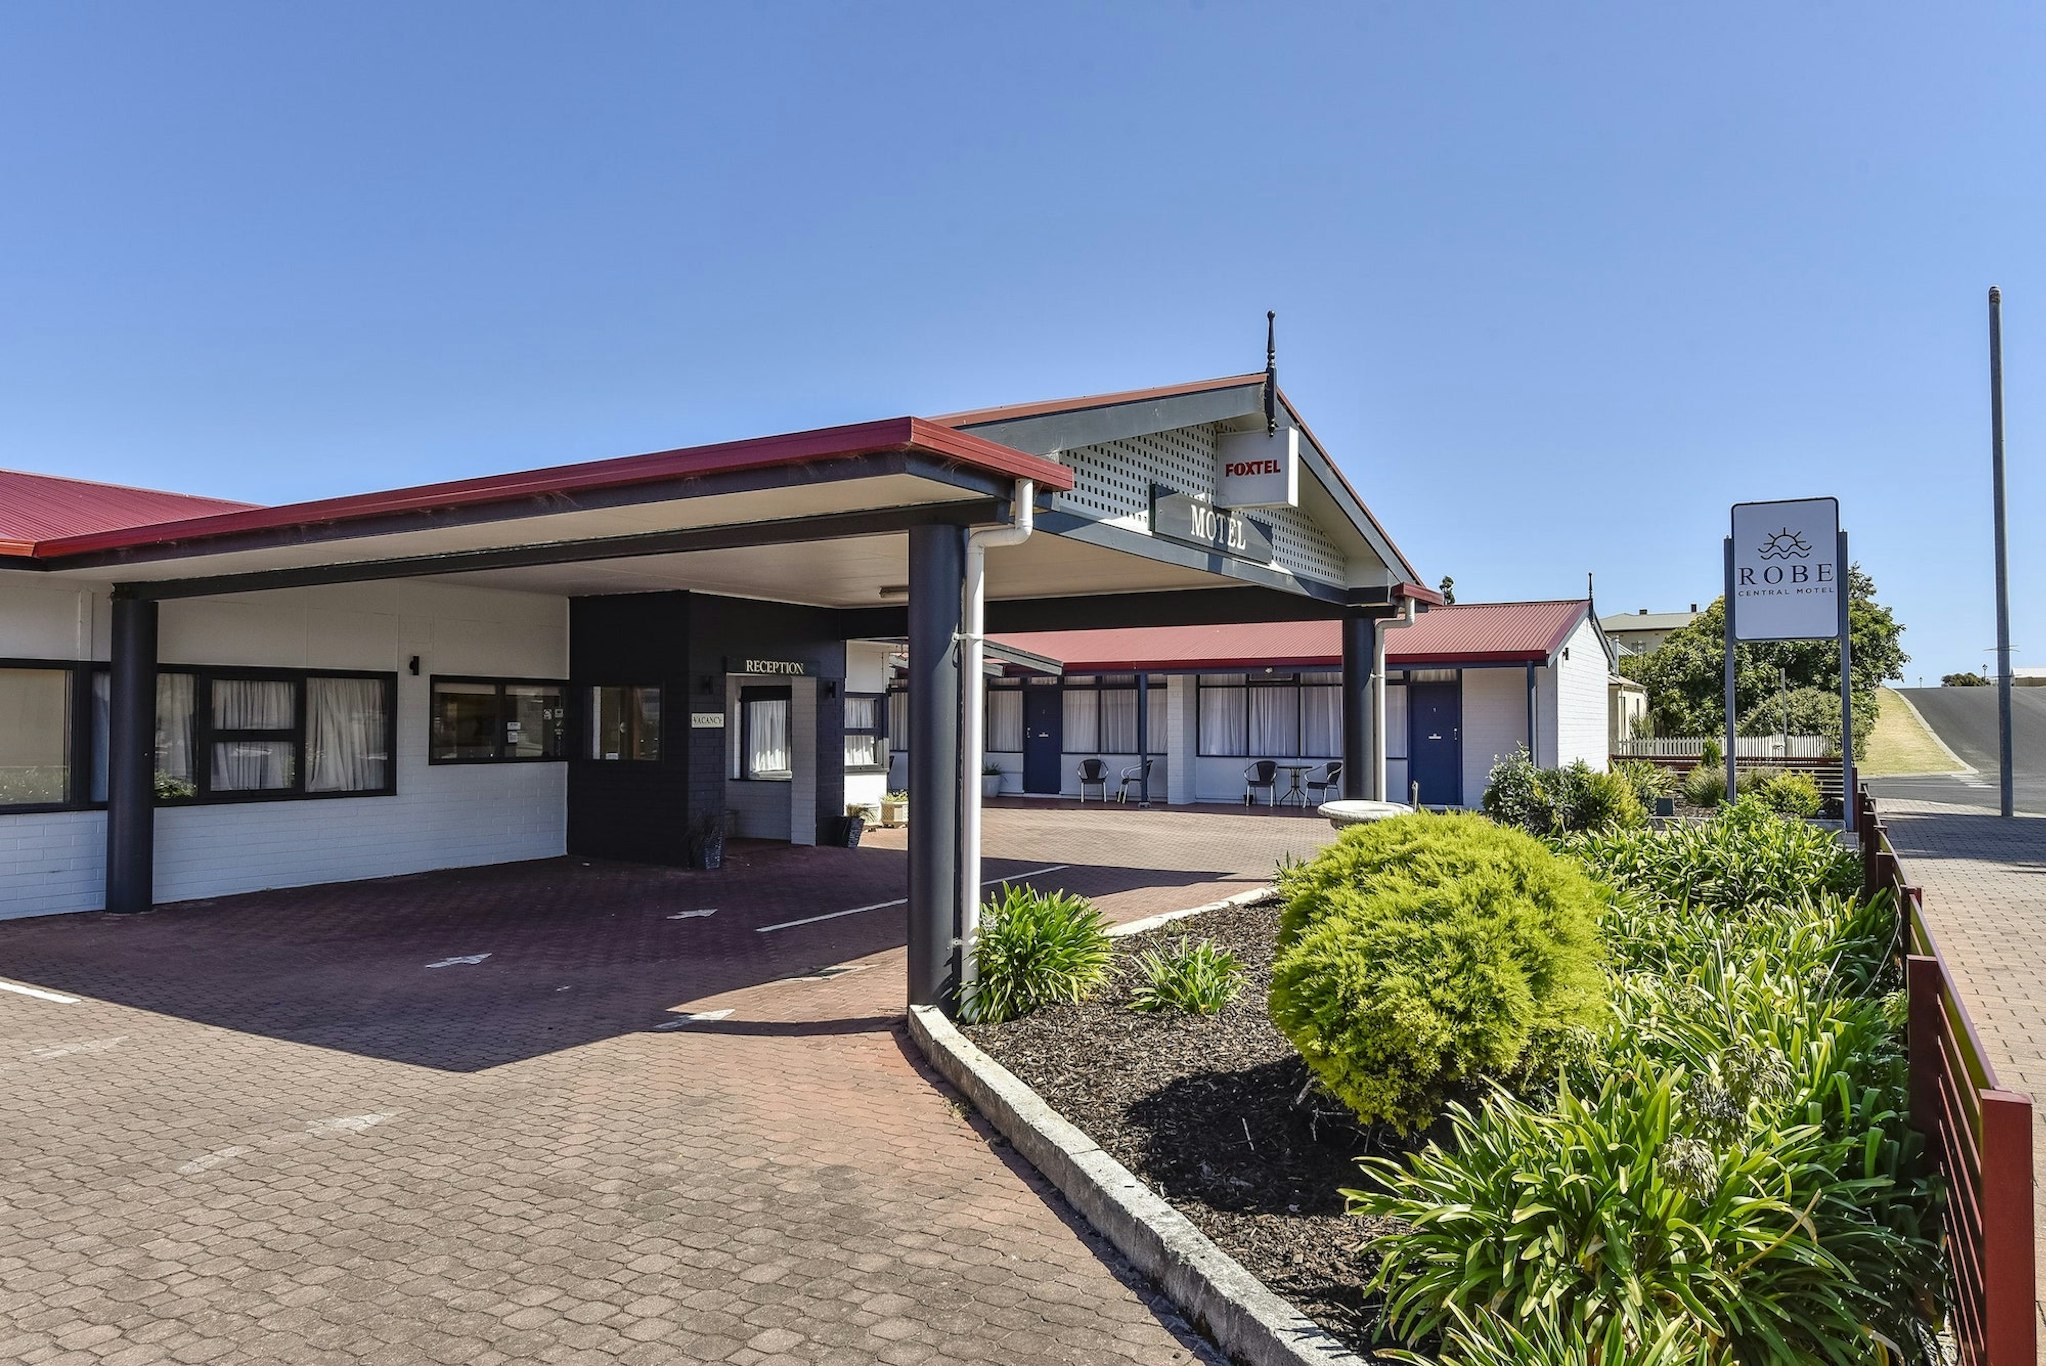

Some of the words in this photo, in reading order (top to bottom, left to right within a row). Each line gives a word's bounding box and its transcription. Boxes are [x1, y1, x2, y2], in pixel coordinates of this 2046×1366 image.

[1225, 459, 1281, 477] FOXTEL
[1190, 504, 1247, 550] MOTEL
[1738, 563, 1834, 586] ROBE
[1738, 588, 1790, 597] CENTRAL
[1796, 586, 1835, 595] MOTEL
[746, 659, 804, 675] RECEPTION
[693, 716, 722, 724] VACANCY
